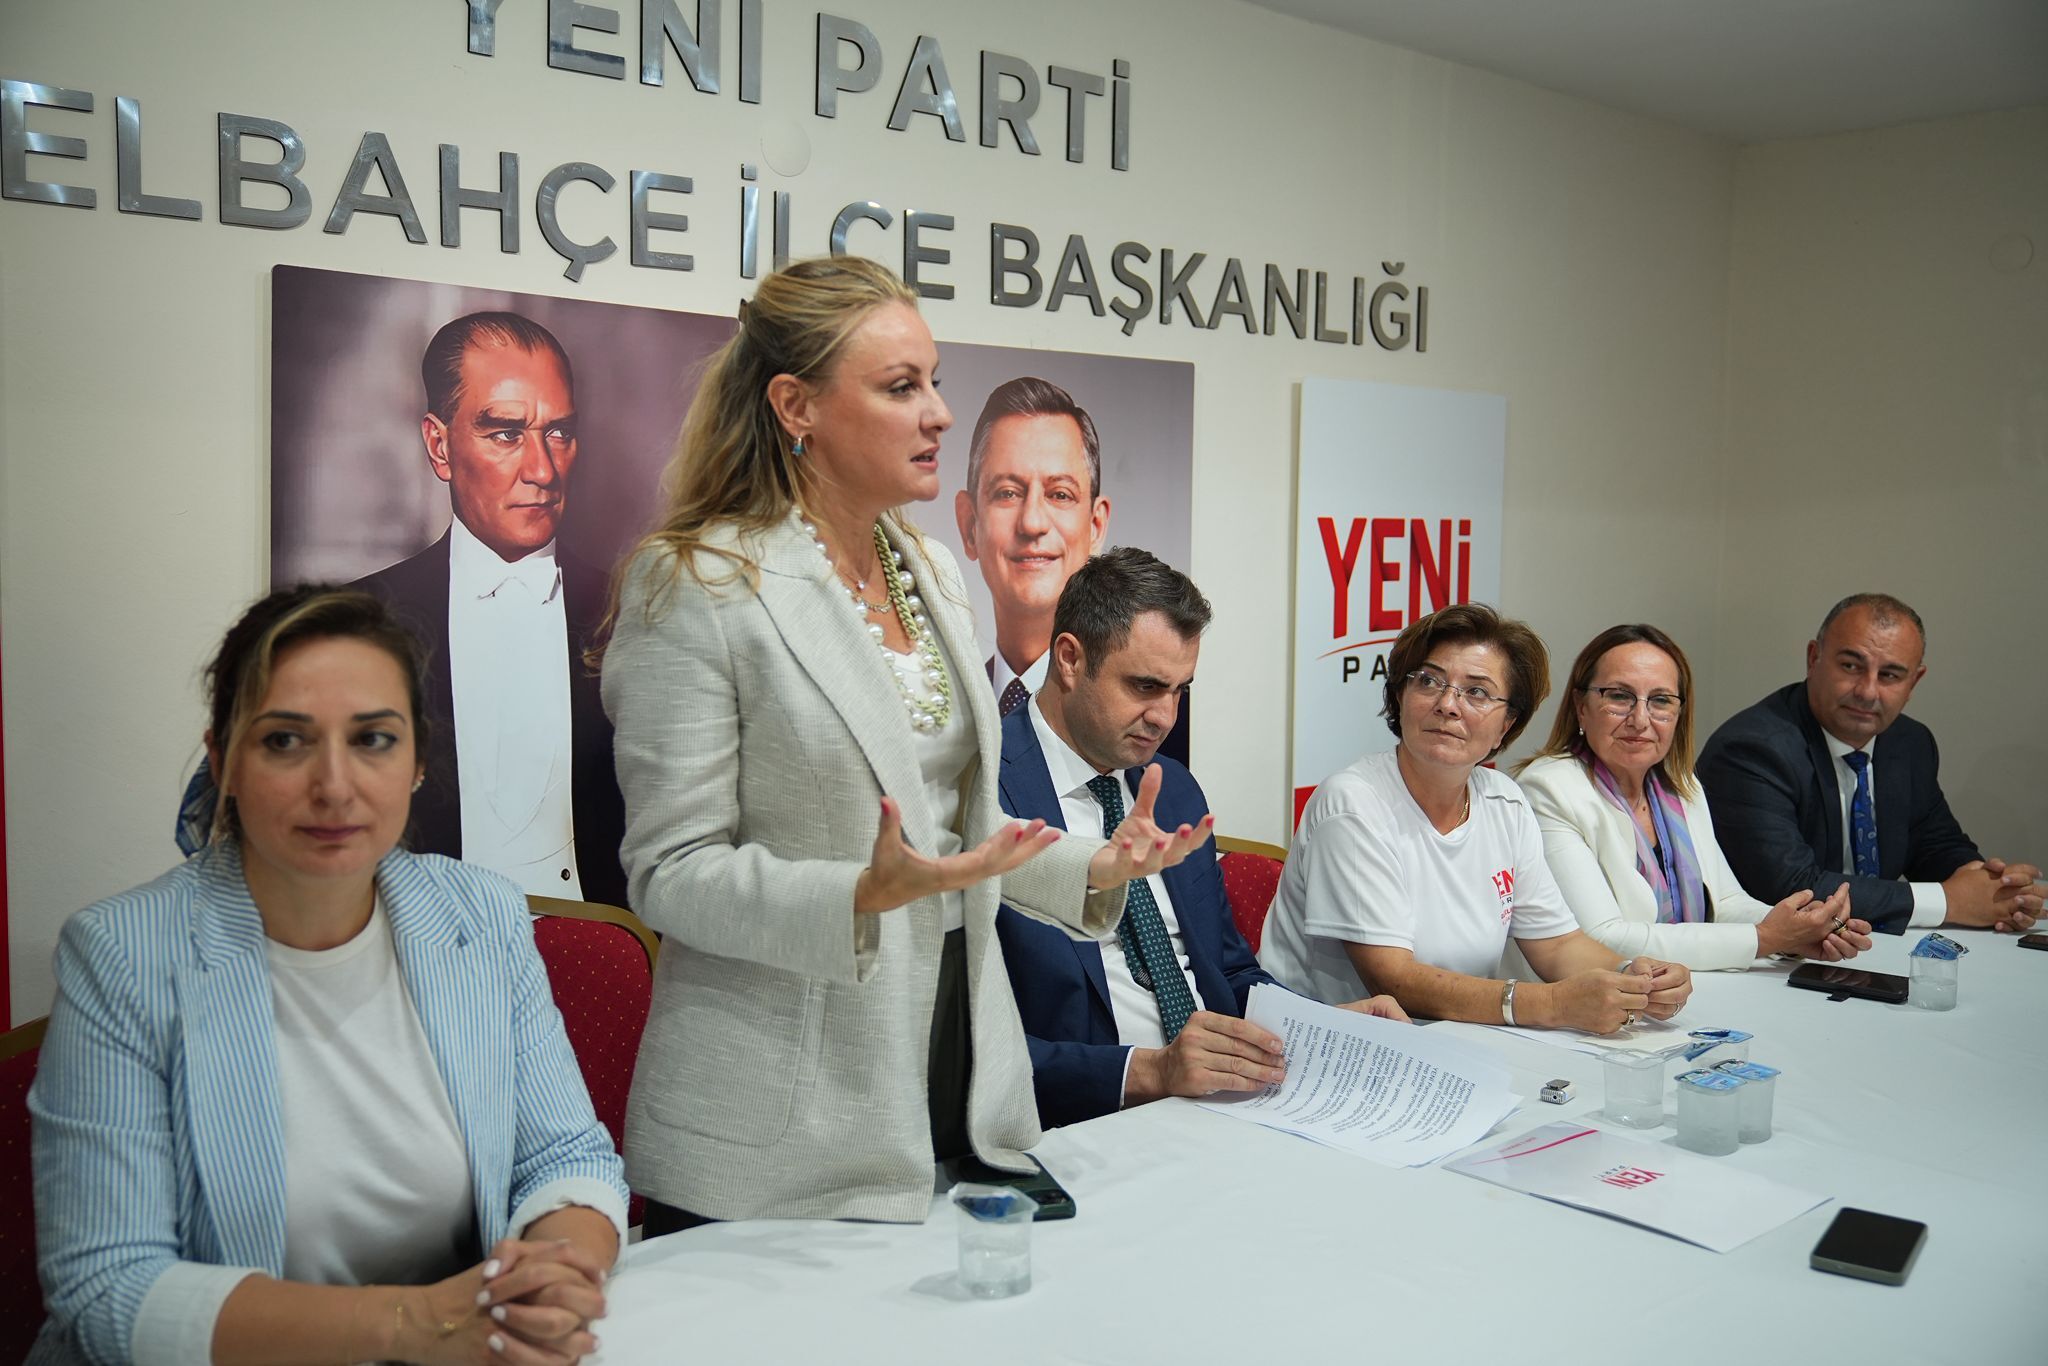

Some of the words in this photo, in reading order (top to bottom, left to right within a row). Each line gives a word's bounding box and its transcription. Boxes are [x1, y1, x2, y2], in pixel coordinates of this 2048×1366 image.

[814, 12, 1130, 171] PARTİ
[0, 79, 694, 283] ELBAHÇE
[991, 222, 1429, 352] BAŞKANLIĞI
